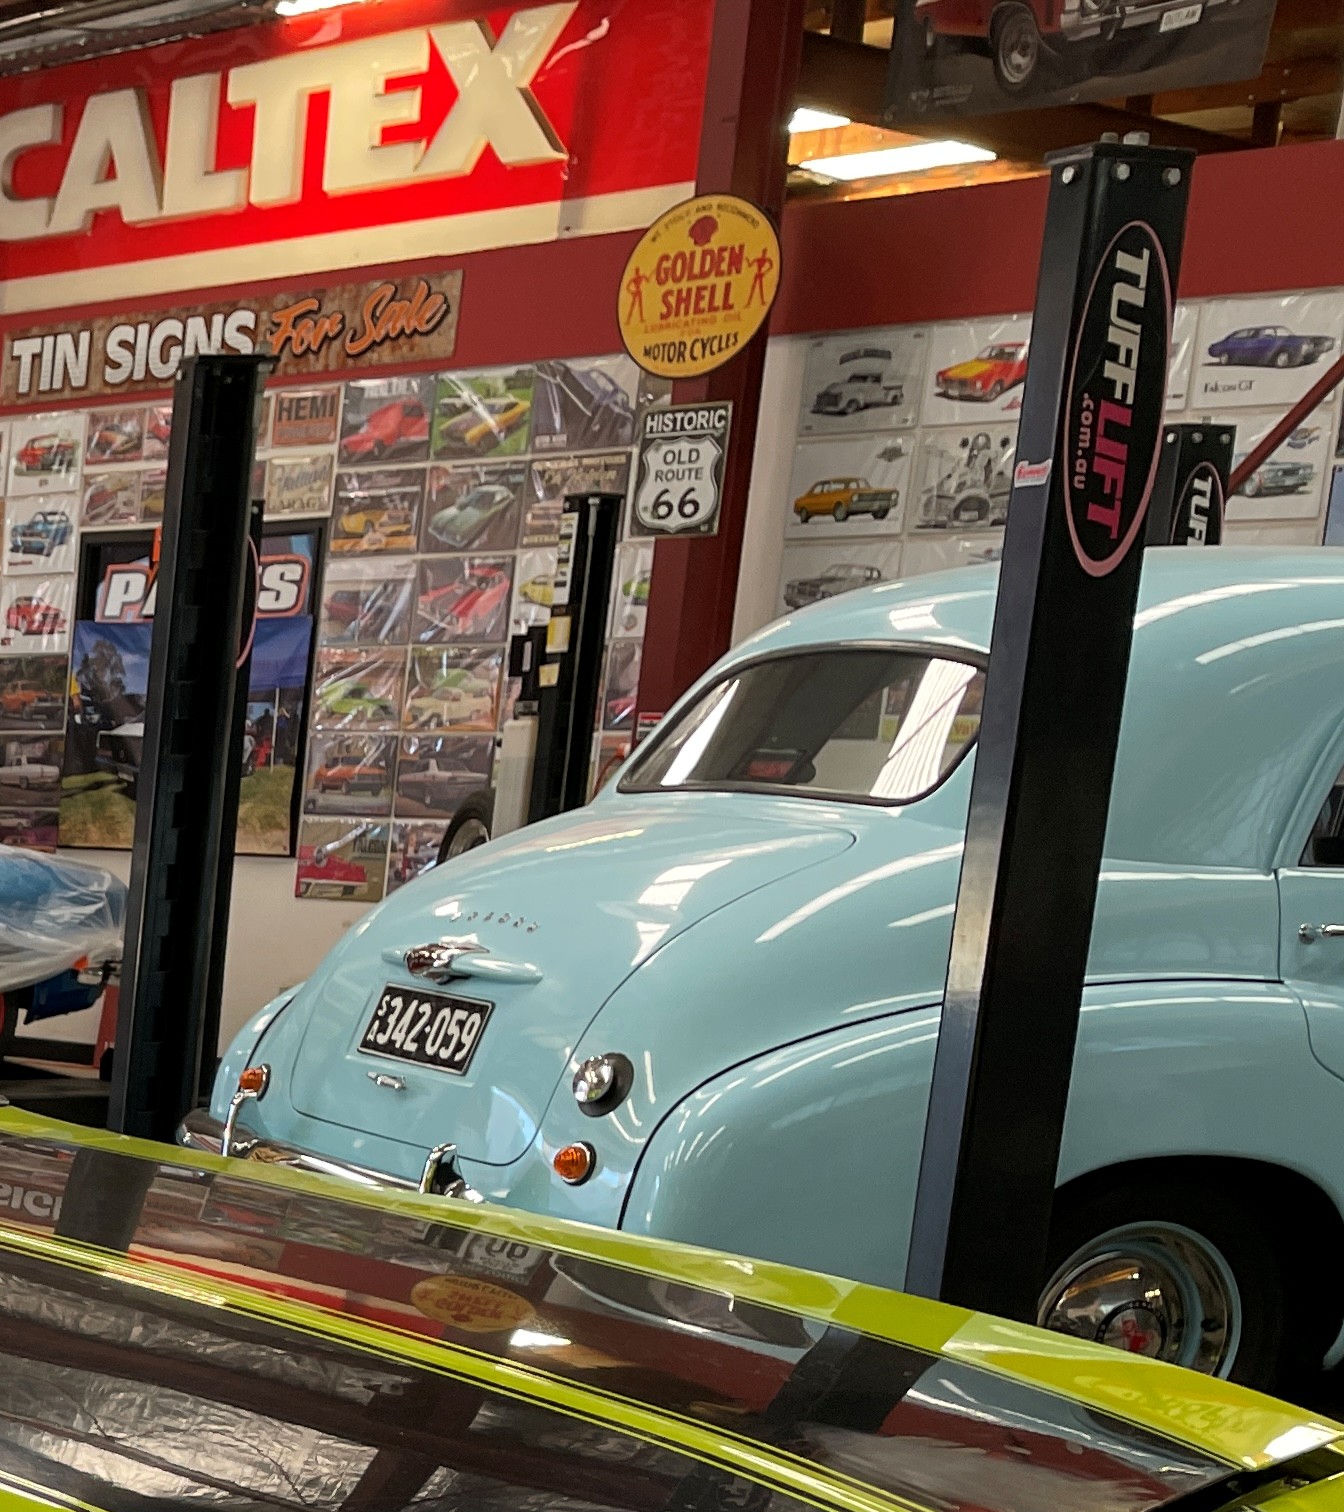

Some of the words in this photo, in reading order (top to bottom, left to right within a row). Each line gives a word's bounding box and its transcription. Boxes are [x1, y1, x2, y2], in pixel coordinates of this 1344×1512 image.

[655, 243, 745, 286] GOLDEN
[659, 281, 735, 321] SHELL
[12, 330, 91, 394] TIN
[104, 309, 257, 385] SIGNS
[267, 298, 343, 356] For
[345, 281, 448, 357] Sale
[643, 340, 687, 363] MOTOR
[690, 331, 740, 361] CYCLES
[277, 394, 336, 423] HEMI
[646, 408, 727, 433] HISTORIC
[663, 448, 700, 466] OLD
[654, 467, 704, 483] ROUTE
[652, 487, 700, 520] 66
